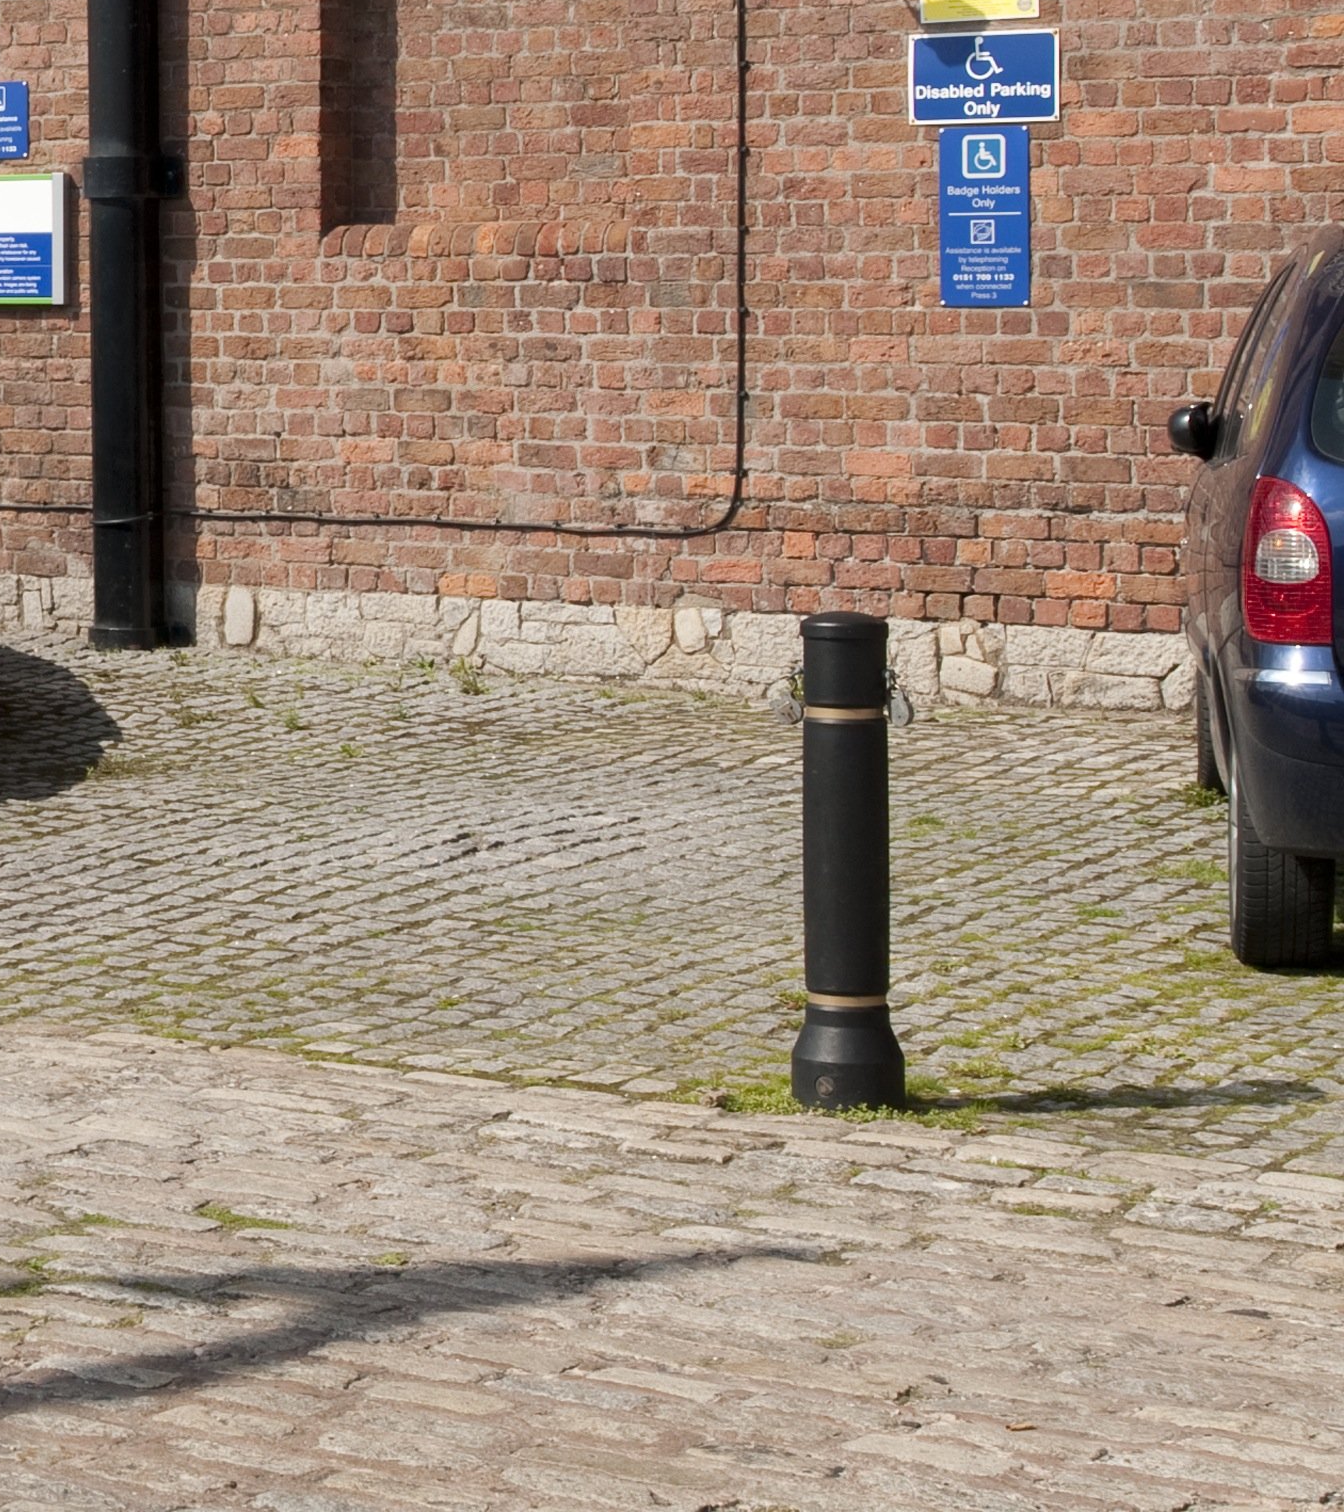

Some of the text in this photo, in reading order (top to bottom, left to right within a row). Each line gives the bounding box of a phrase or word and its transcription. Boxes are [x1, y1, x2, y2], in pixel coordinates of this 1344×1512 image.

[915, 81, 1051, 99] Disabled Parking
[963, 101, 1001, 118] Only
[947, 185, 1021, 197] Badge Holders
[972, 198, 996, 209] Only
